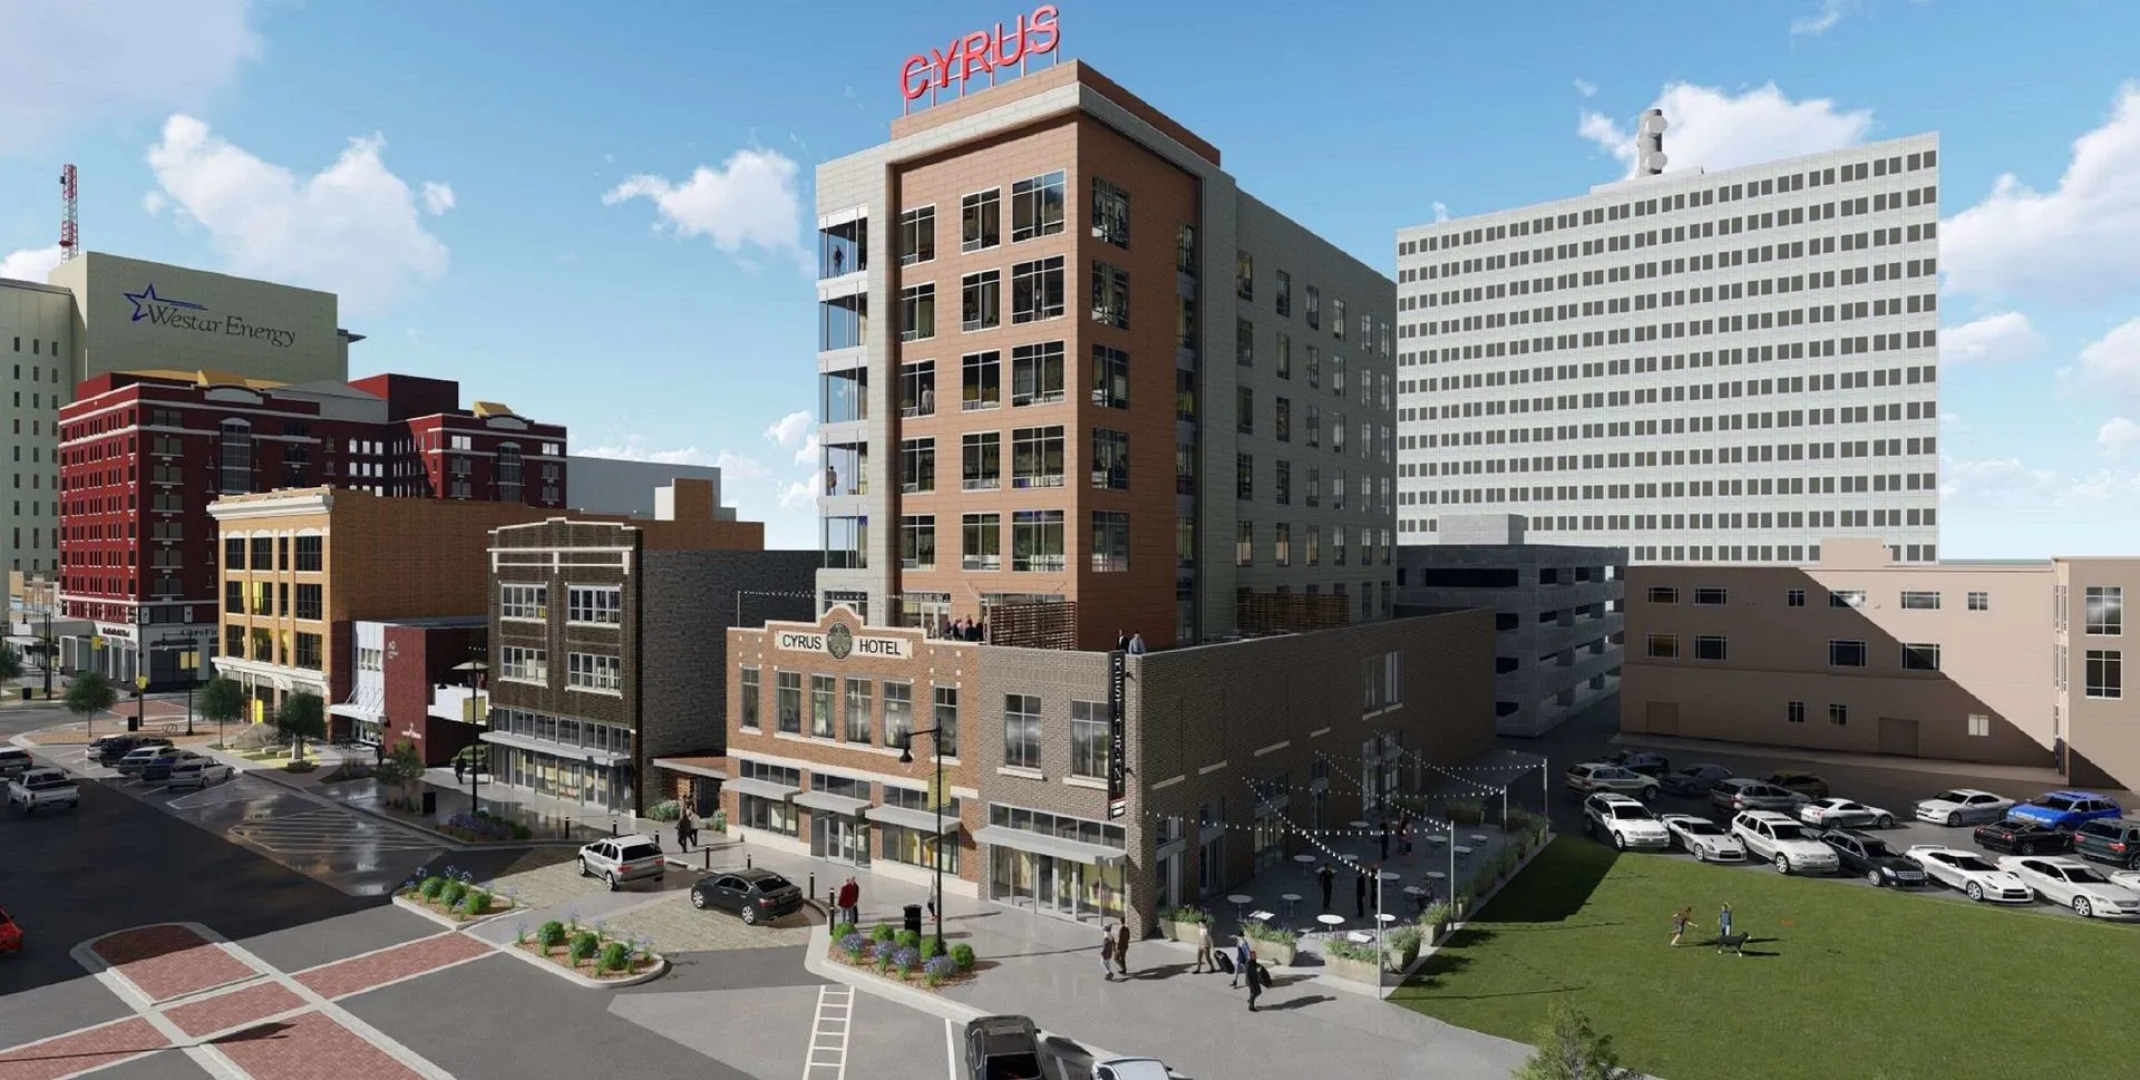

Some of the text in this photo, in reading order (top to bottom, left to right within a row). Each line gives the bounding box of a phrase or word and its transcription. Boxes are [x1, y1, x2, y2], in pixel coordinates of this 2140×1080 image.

[901, 5, 1059, 99] CYRUS
[148, 304, 296, 348] Westar Energy
[782, 634, 902, 655] CYRUS HOTEL
[1114, 657, 1122, 793] RESTAURANT
